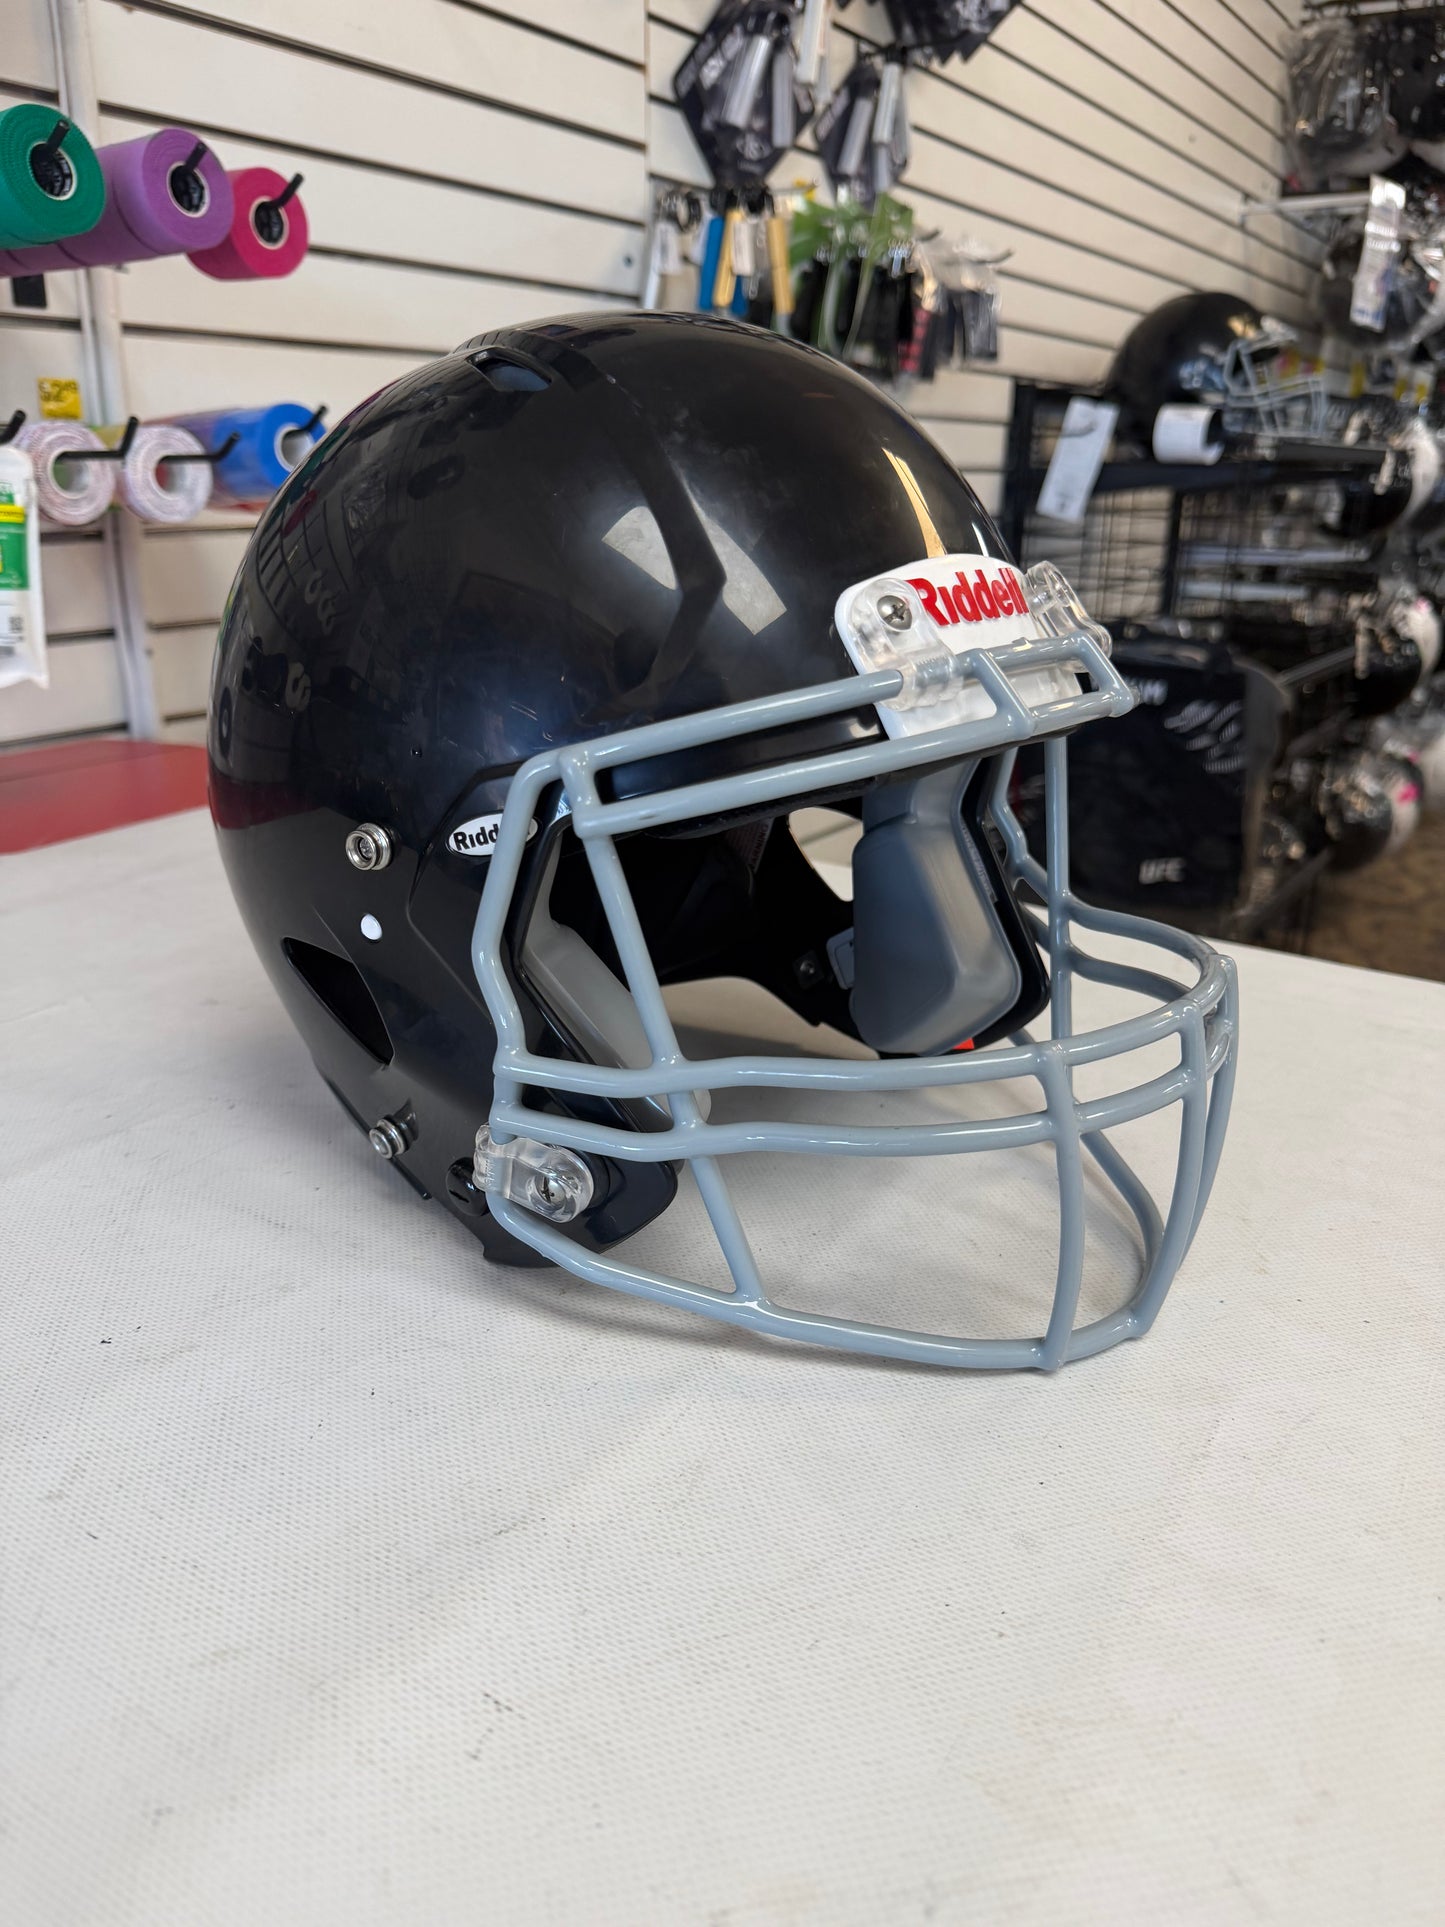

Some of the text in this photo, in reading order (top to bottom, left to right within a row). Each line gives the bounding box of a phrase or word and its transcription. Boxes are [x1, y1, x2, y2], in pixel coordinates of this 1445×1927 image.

[904, 567, 1030, 627] Riddell
[453, 823, 501, 851] Ridd
[751, 823, 769, 867] ARNING
[1138, 857, 1188, 885] UFC
